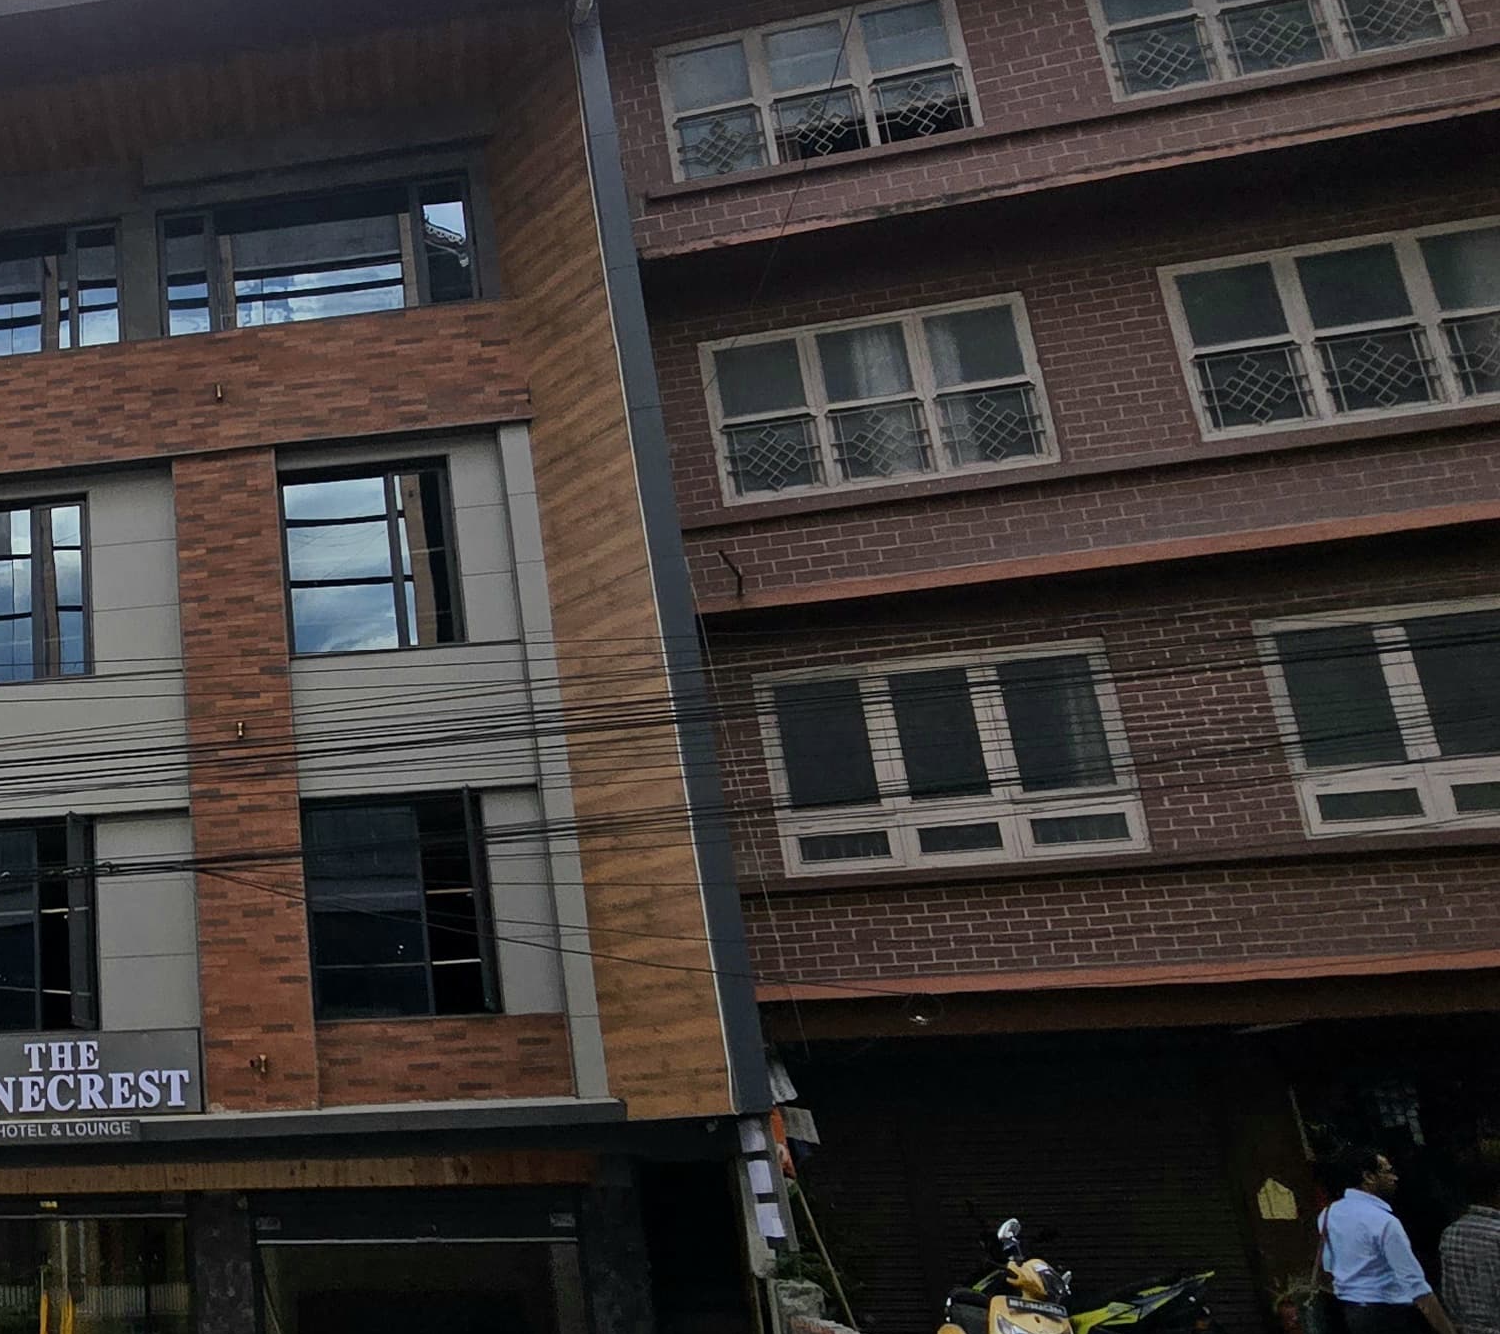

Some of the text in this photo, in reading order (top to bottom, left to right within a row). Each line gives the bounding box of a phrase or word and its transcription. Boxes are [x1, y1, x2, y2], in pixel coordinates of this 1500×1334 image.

[24, 1040, 100, 1072] THE
[50, 1122, 62, 1137] &
[66, 1121, 131, 1137] LOUNGE
